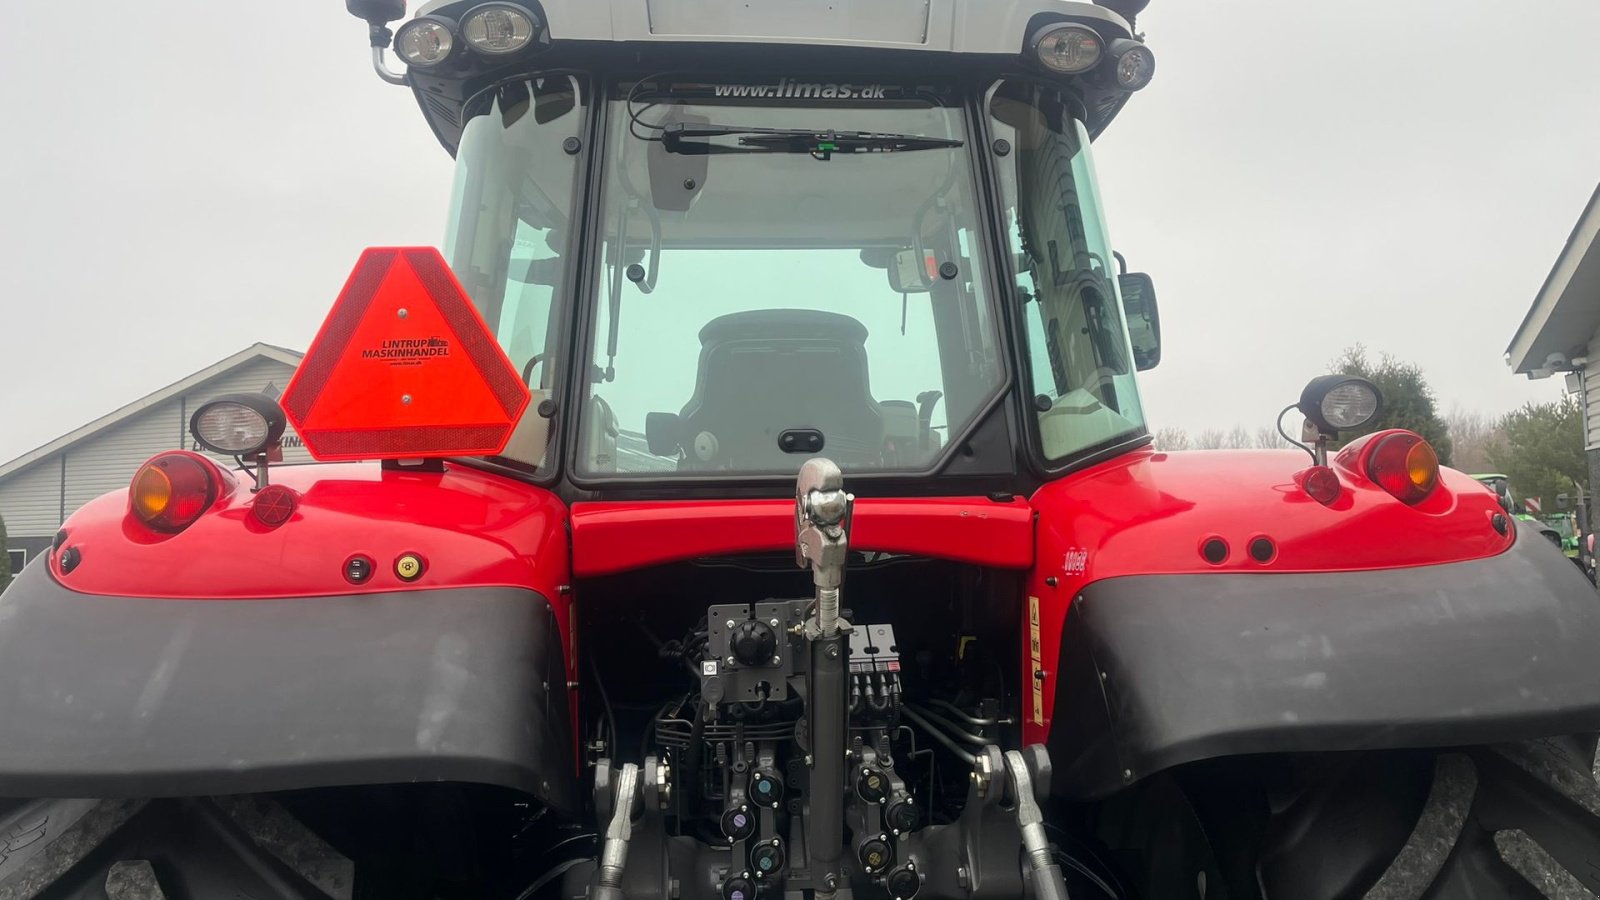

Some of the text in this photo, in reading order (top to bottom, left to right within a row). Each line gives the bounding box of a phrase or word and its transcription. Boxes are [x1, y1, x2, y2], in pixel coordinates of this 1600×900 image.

[715, 77, 885, 99] www.limas.dk
[382, 340, 427, 348] LINTRUP
[362, 348, 449, 358] MASKINHANDEL
